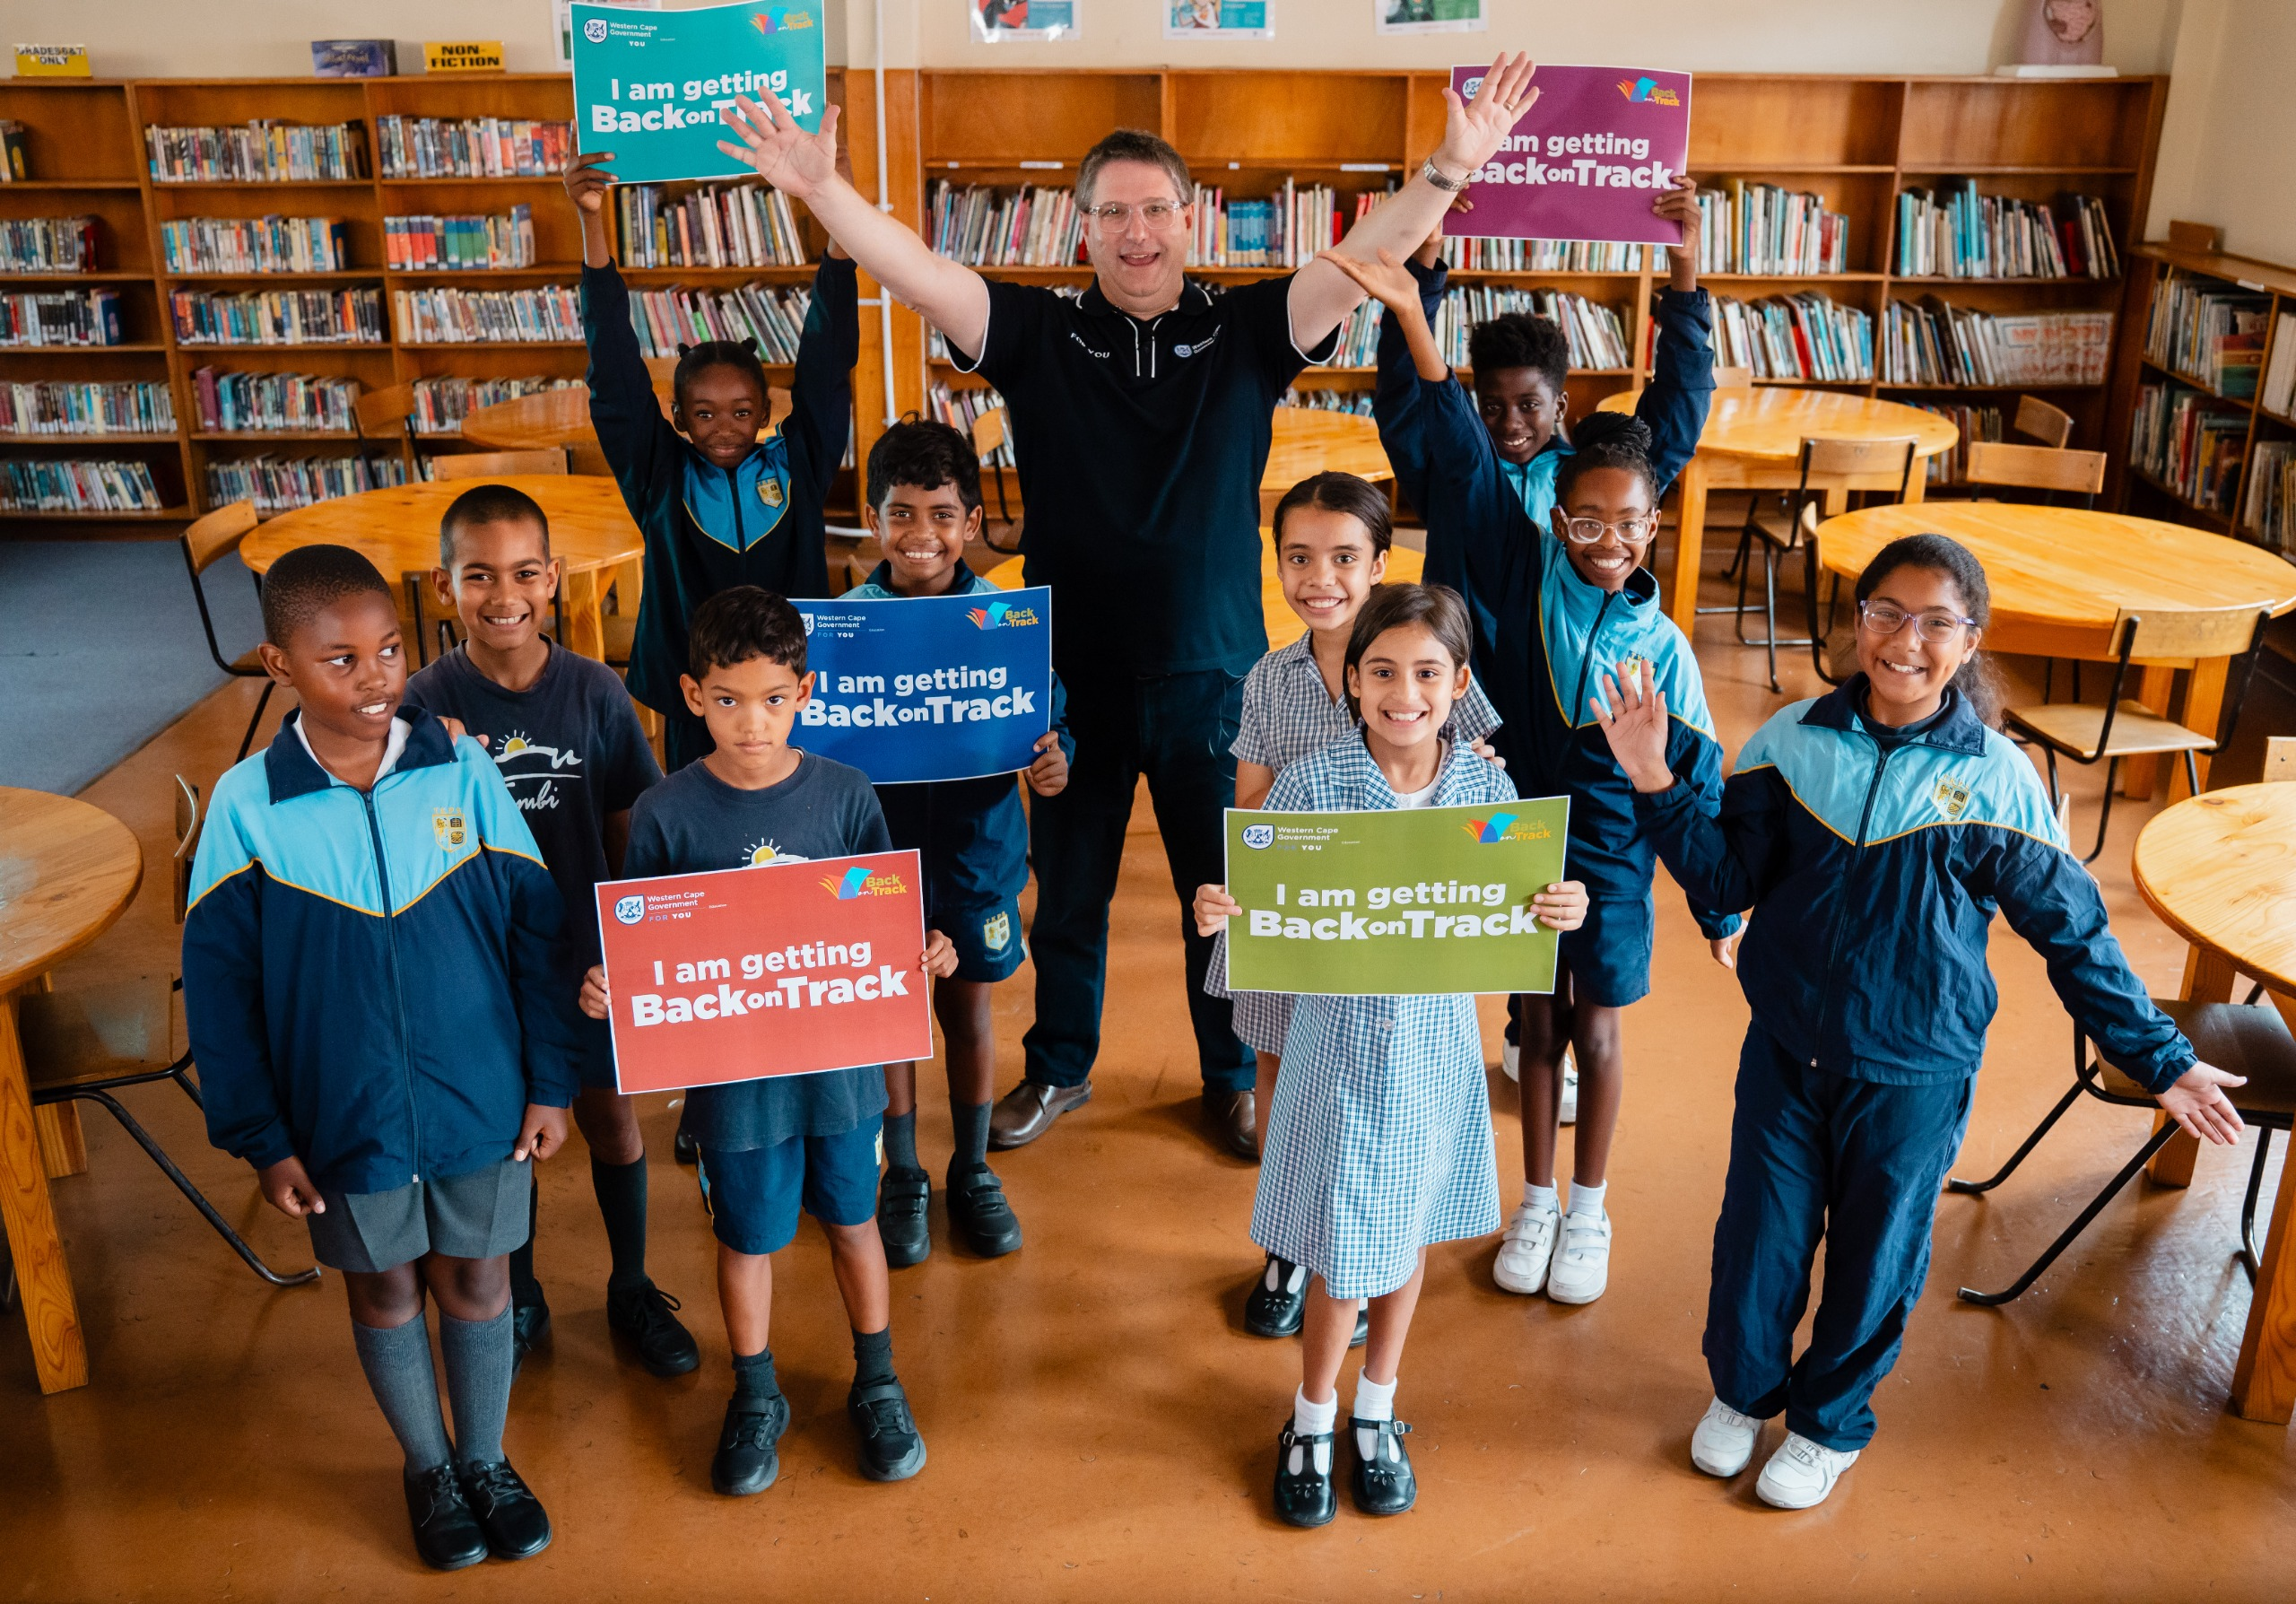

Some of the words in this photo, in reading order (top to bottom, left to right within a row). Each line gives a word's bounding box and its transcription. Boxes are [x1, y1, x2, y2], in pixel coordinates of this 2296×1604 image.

[610, 30, 651, 38] Government
[39, 57, 68, 65] ONLY
[430, 57, 500, 67] FICTION
[611, 78, 619, 100] I
[629, 82, 674, 100] am
[683, 69, 787, 101] getting
[1655, 96, 1680, 106] Track
[1498, 135, 1539, 153] am
[1546, 133, 1649, 160] getting
[1005, 607, 1034, 620] Back
[1010, 616, 1039, 628] Track
[820, 671, 828, 693] I
[838, 675, 885, 693] am
[894, 666, 1007, 697] getting
[1509, 819, 1546, 833] Back
[1515, 829, 1551, 841] Track
[866, 874, 900, 887] Back
[872, 884, 907, 896] Track
[1276, 884, 1285, 905] I
[1298, 886, 1355, 907] am
[1367, 880, 1506, 910] getting
[648, 894, 681, 902] Western
[648, 900, 698, 911] Government
[654, 961, 664, 986] I
[675, 957, 731, 984] am
[741, 941, 872, 981] getting
